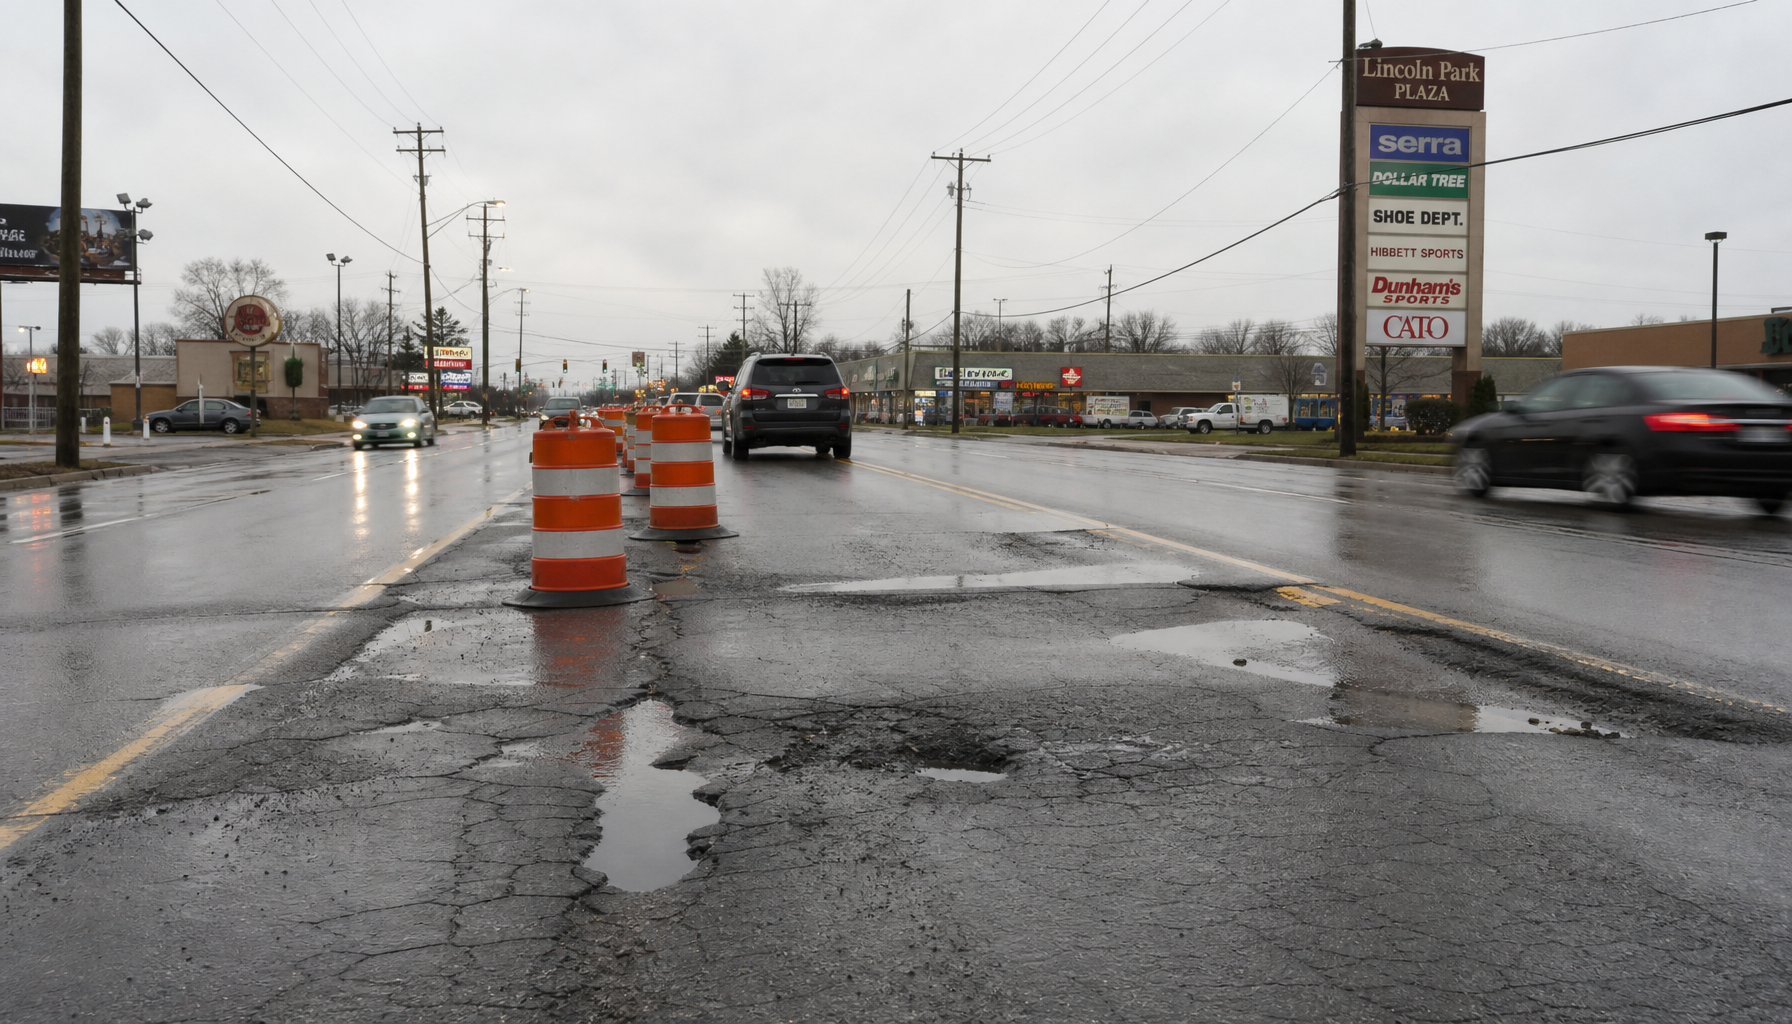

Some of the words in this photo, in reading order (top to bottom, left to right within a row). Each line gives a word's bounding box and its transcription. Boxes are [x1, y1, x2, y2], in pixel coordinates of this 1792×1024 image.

[1363, 57, 1433, 80] Lincoln
[1439, 61, 1481, 82] Park
[1394, 83, 1450, 101] PLAZA
[1378, 135, 1462, 154] serra
[1372, 172, 1427, 186] DOLLAR
[1431, 174, 1466, 188] TREE
[1373, 210, 1414, 224] SHOE
[1421, 211, 1463, 226] DEPT.
[1370, 247, 1417, 257] HIBBETT
[1421, 248, 1464, 259] SPORTS
[1372, 276, 1461, 295] Dunham's
[1383, 295, 1450, 304] SPORTS
[1383, 315, 1449, 339] CATO
